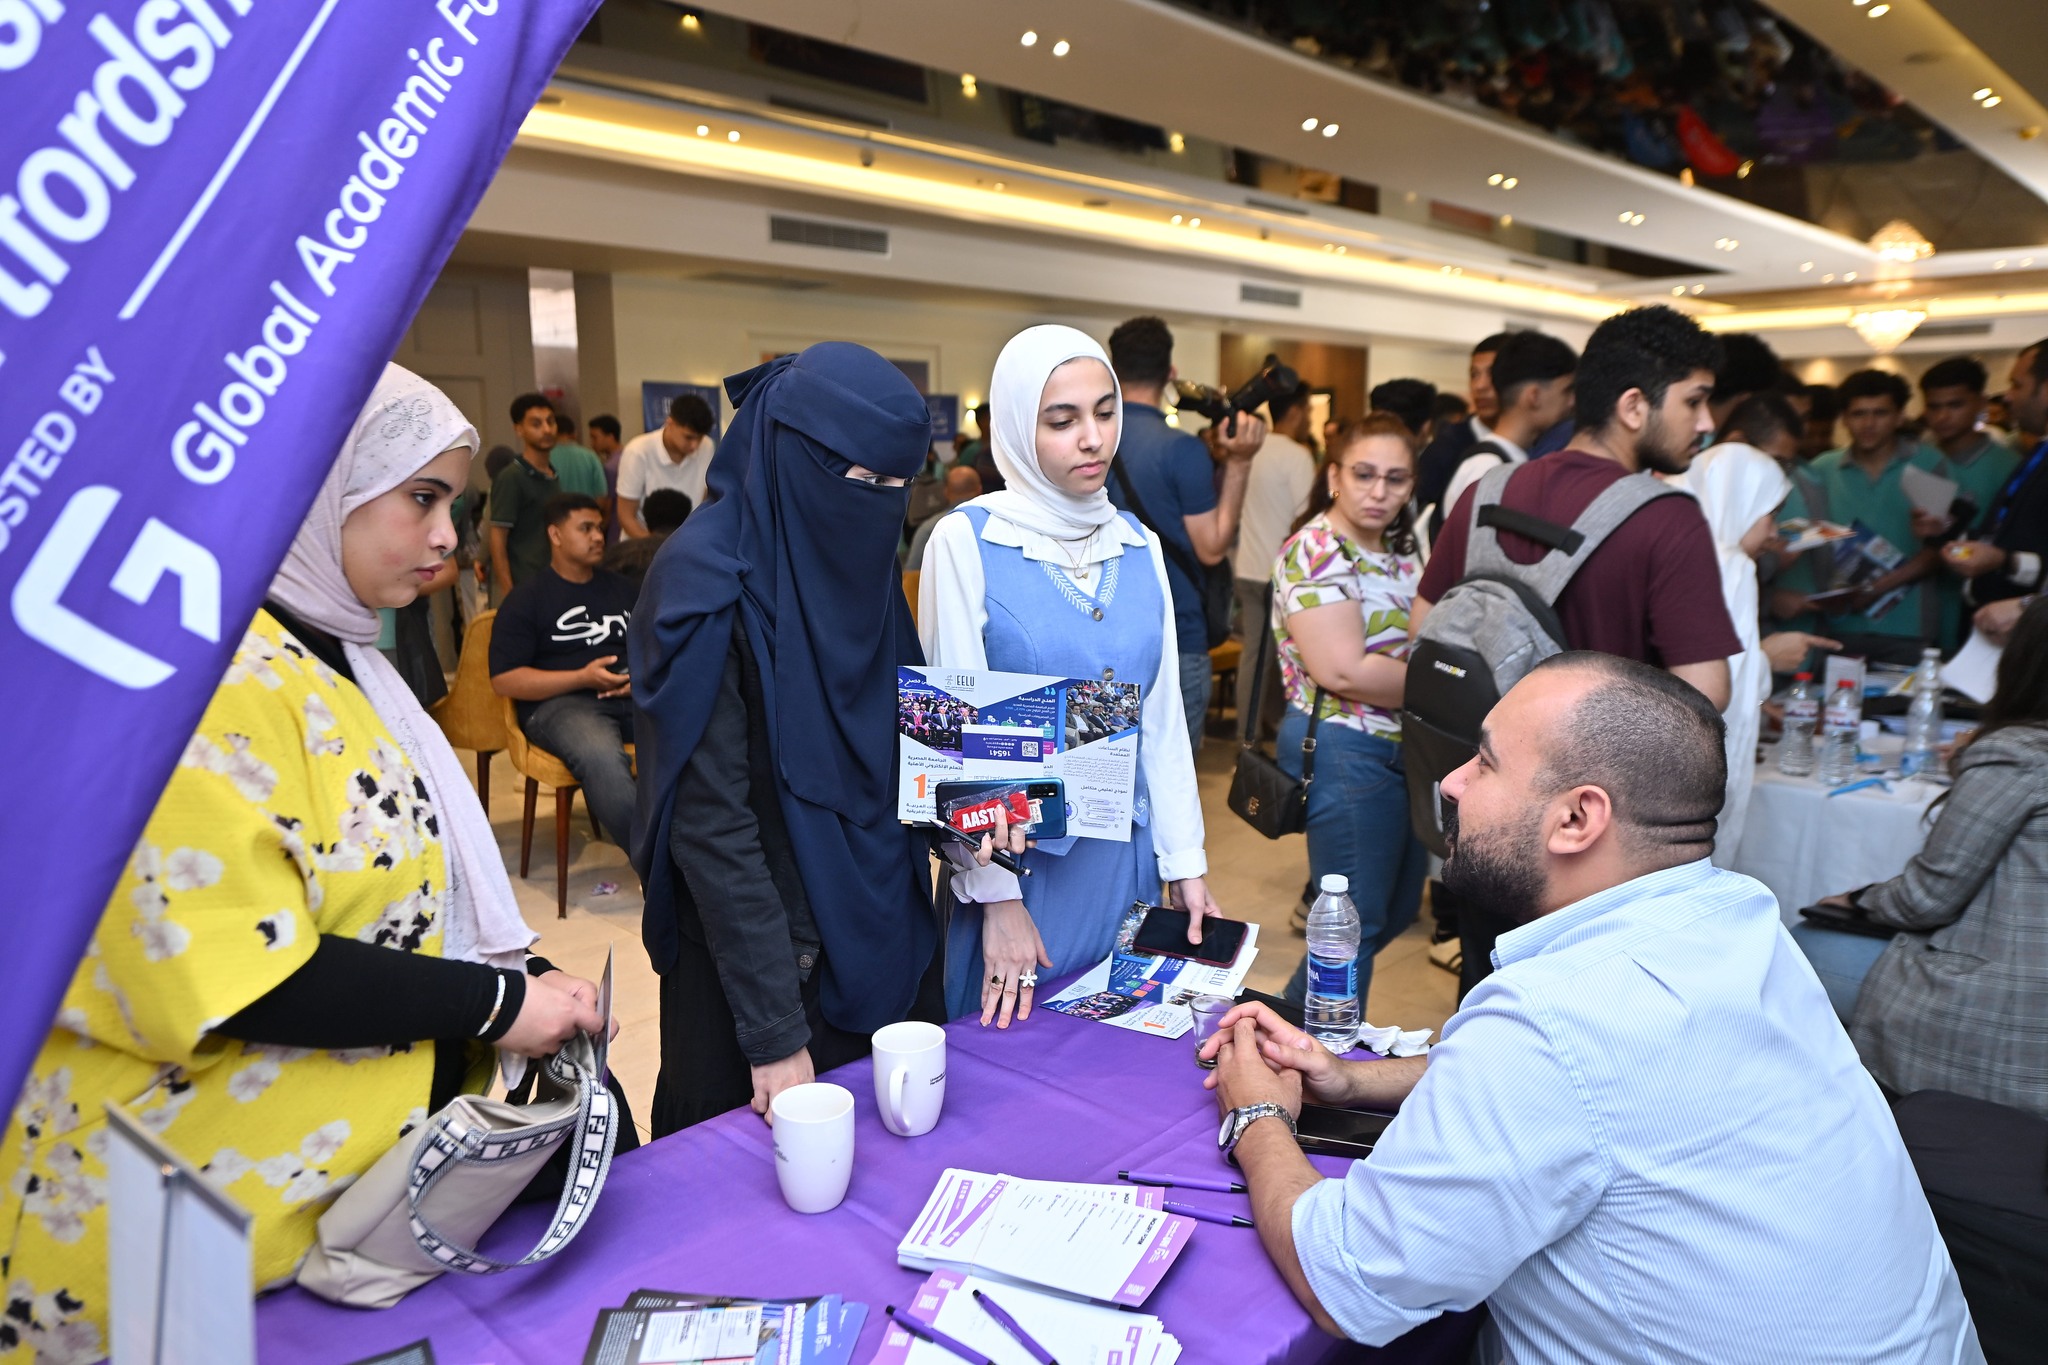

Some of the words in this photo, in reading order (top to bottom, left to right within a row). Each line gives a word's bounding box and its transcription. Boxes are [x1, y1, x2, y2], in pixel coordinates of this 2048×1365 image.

[171, 280, 321, 485] Global
[295, 36, 465, 298] Academic
[0, 410, 78, 553] STED
[58, 344, 117, 416] BY
[956, 675, 975, 687] EELU
[913, 774, 926, 799] 1
